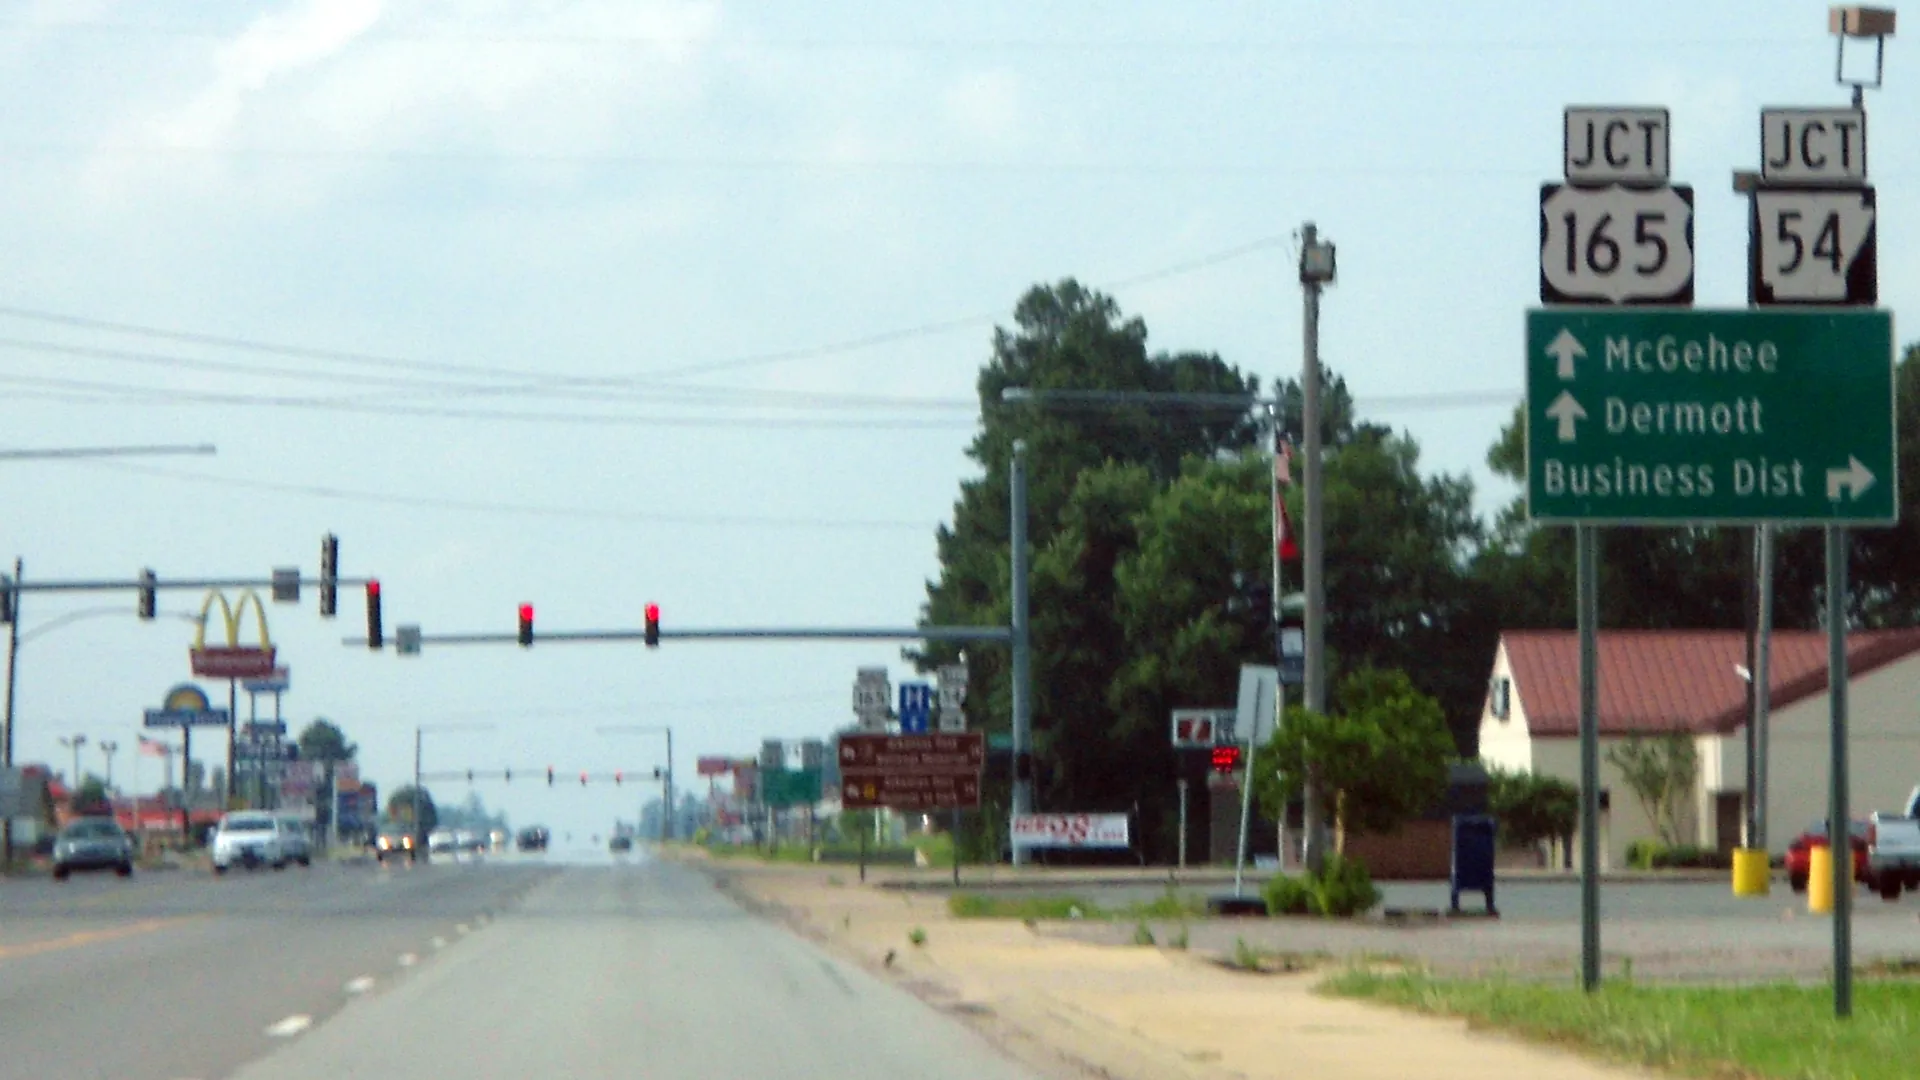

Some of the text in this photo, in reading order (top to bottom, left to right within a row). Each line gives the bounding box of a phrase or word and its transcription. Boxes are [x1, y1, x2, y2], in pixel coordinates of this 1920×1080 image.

[1572, 119, 1661, 169] JCT
[1769, 120, 1858, 170] JCT
[1563, 210, 1669, 276] 165
[1777, 210, 1844, 276] 54
[1604, 334, 1779, 373] McGehee
[1604, 396, 1764, 434] Dermott
[1543, 456, 1805, 497] Business Dist
